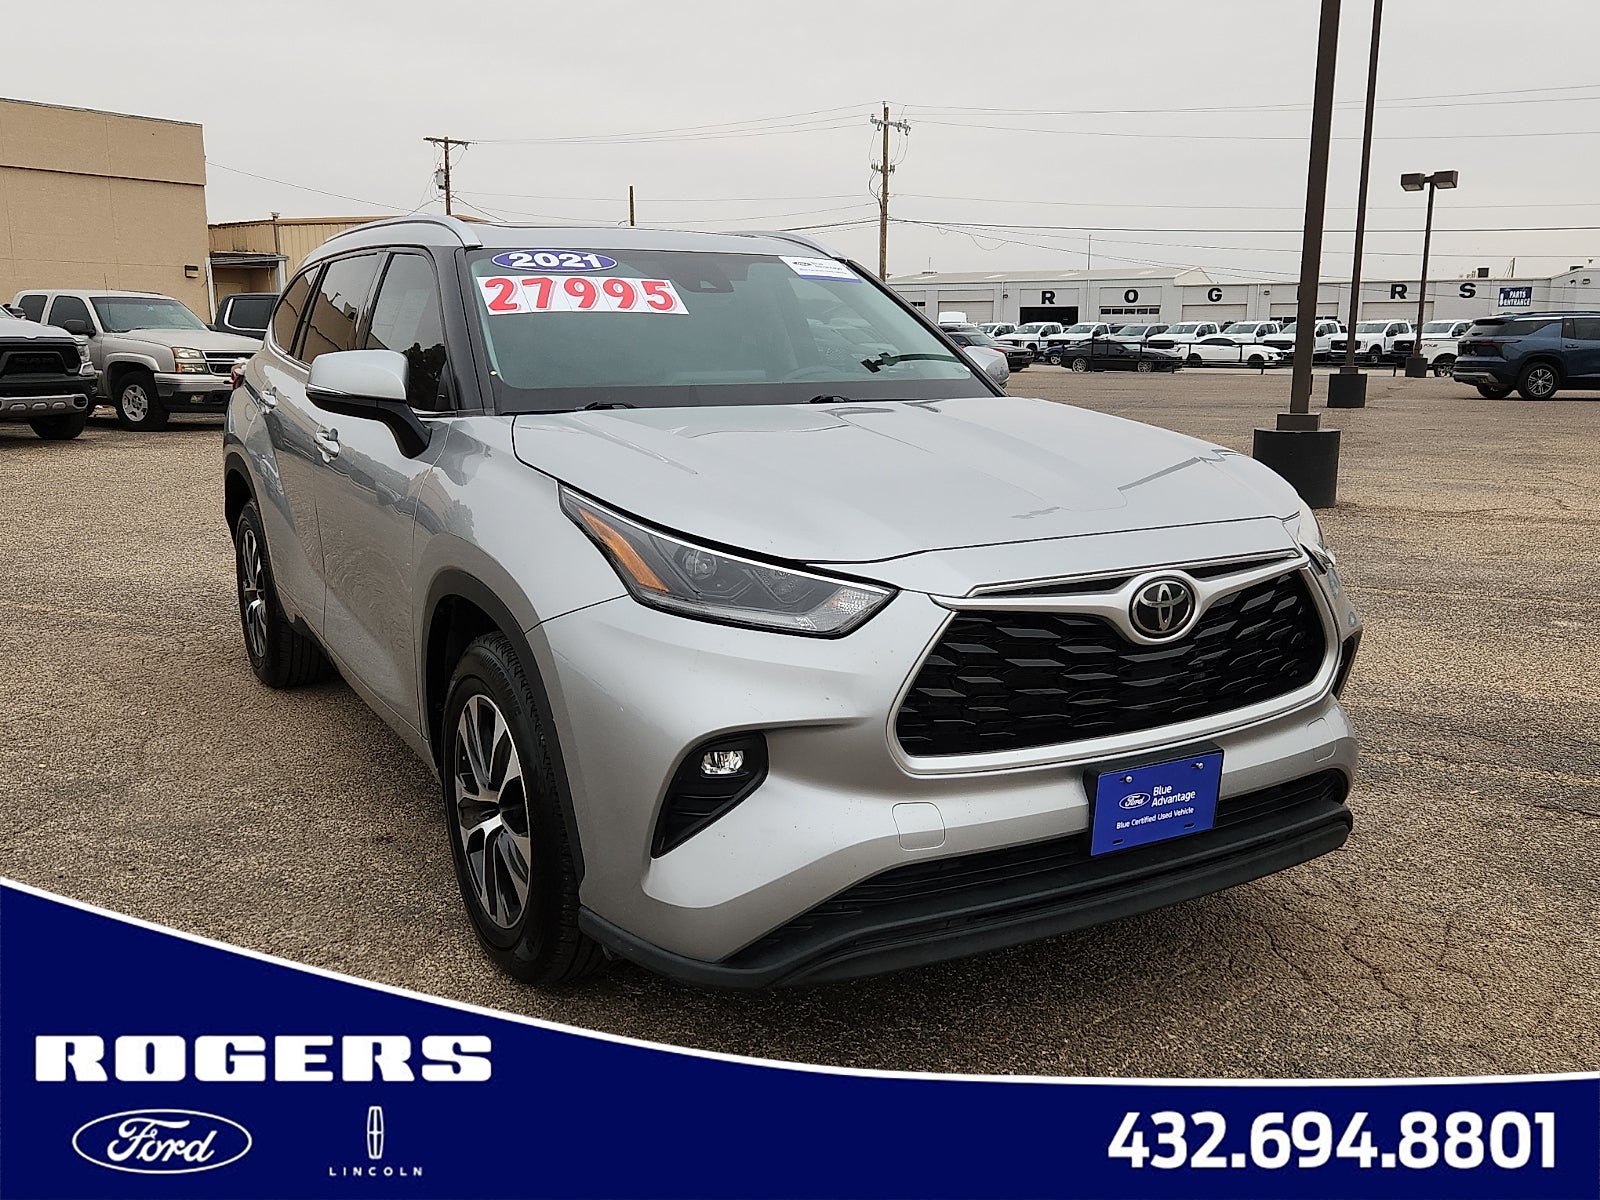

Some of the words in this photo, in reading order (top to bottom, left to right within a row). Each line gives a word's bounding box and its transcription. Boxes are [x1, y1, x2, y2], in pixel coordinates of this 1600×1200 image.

[508, 252, 603, 269] 2021
[484, 277, 680, 312] 27995
[1509, 290, 1527, 298] PARTS
[1503, 297, 1531, 306] ENTRANCE
[1152, 785, 1173, 796] Blue
[1124, 794, 1146, 807] Ford
[1151, 791, 1196, 807] Advantage
[1116, 821, 1130, 829] Blue
[1131, 814, 1157, 826] Certified
[1157, 811, 1173, 820] Used
[1173, 807, 1195, 817] Vehicle
